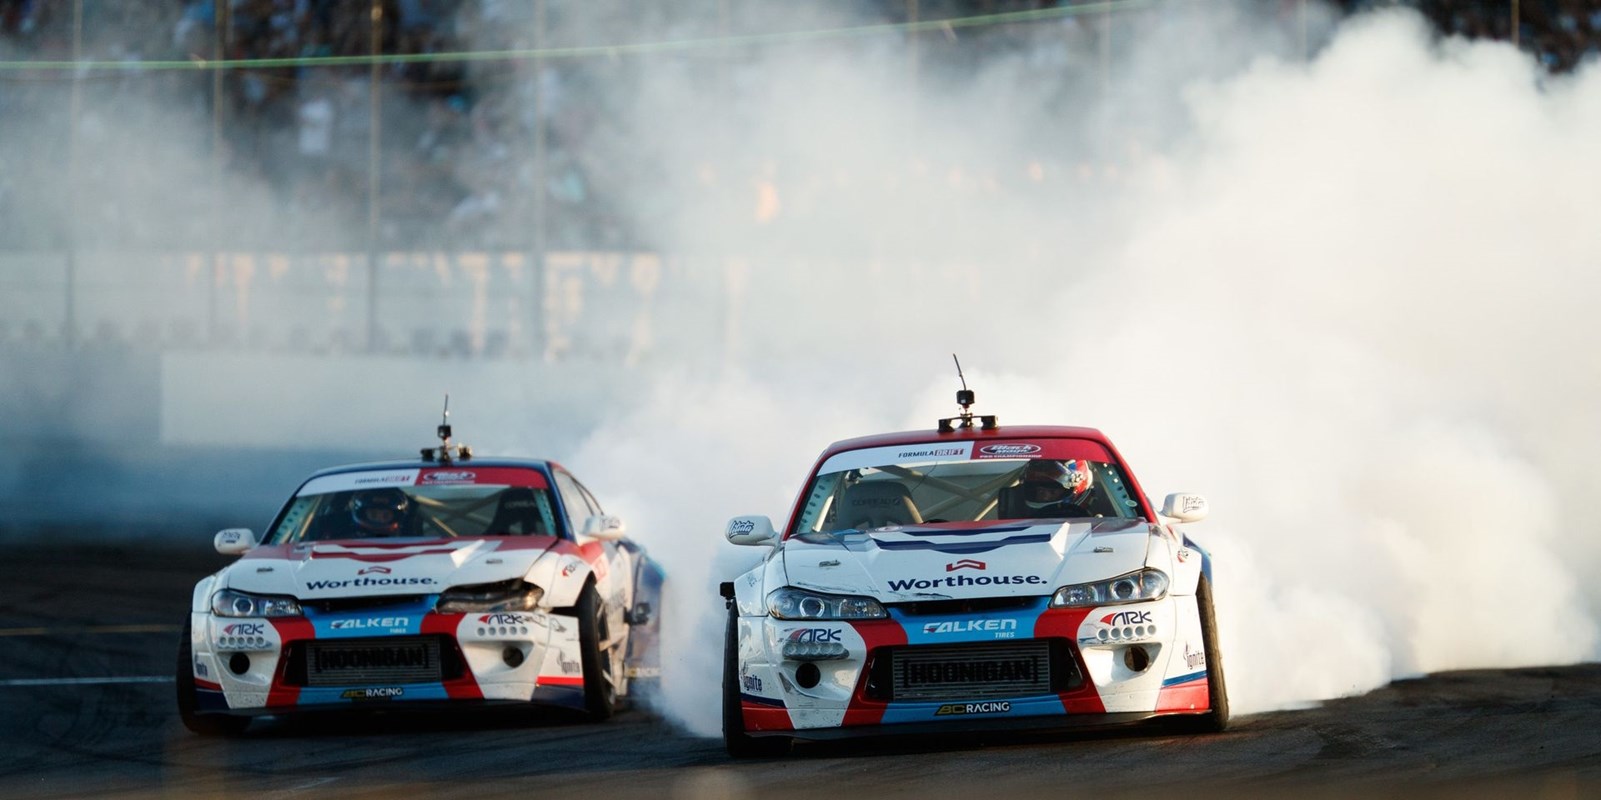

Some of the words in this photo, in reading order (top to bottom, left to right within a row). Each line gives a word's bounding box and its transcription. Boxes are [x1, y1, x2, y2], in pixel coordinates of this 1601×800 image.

[306, 577, 438, 590] Worthouse.
[888, 575, 1048, 592] Worthouse.
[330, 617, 409, 629] FALKEN
[478, 613, 524, 625] ARK
[1100, 610, 1153, 626] ARK
[223, 623, 265, 636] ARK
[923, 618, 1017, 634] FALKEN
[789, 628, 843, 642] ARK
